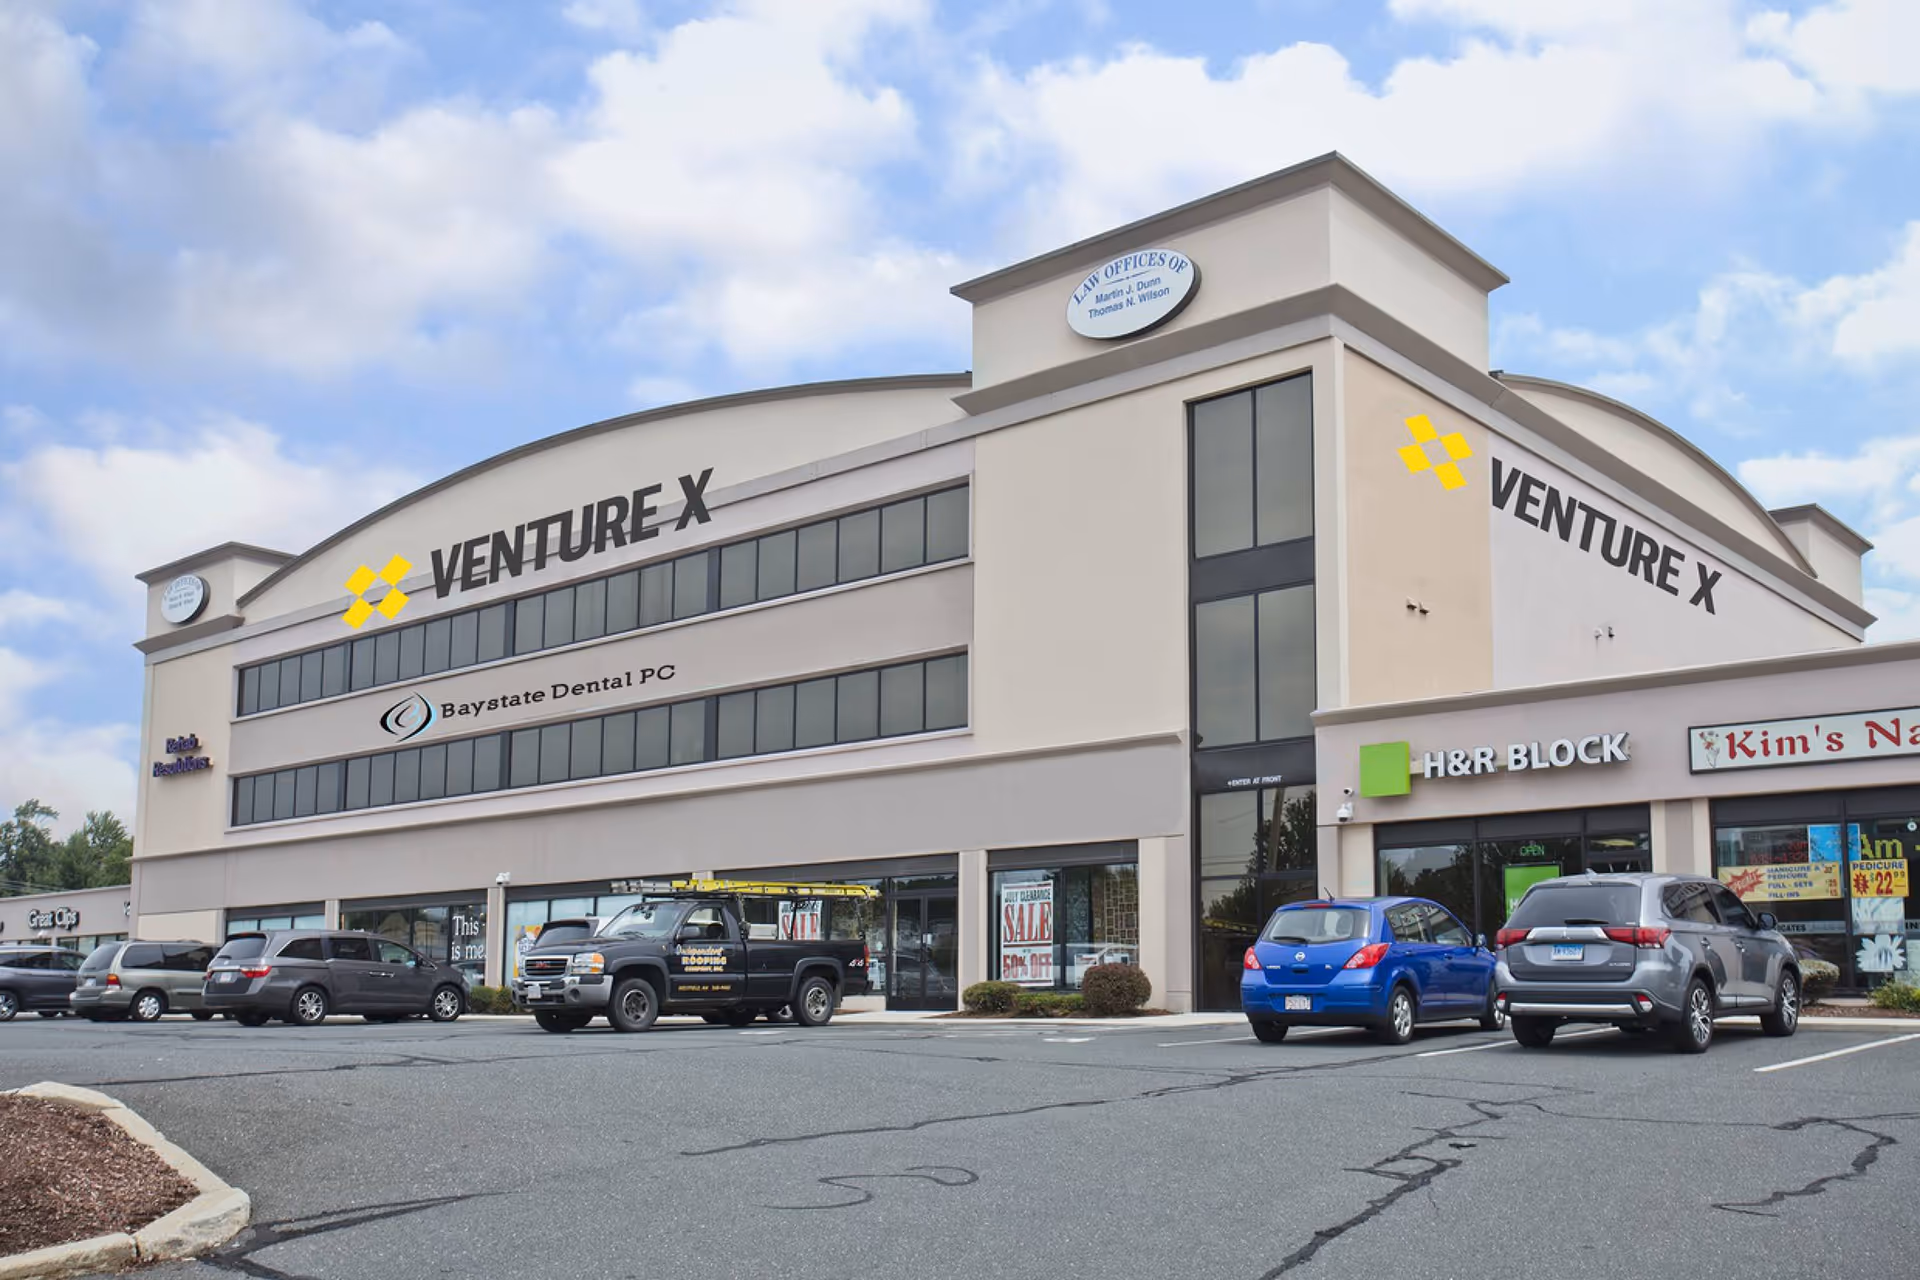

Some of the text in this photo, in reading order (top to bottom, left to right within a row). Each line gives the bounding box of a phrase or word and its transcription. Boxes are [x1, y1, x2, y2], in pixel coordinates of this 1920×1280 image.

[1073, 252, 1189, 305] LAW OFFICES OF
[1095, 277, 1161, 304] Martin J. Dunn
[1089, 287, 1170, 319] Thomas N. Wilson
[431, 467, 714, 599] VENTURE X
[1492, 457, 1723, 615] VENTURE X
[441, 665, 676, 718] Baystate Dental PC
[1424, 732, 1631, 779] H&R BLOCK
[1725, 724, 1845, 761] Kim's
[1232, 778, 1251, 787] ENTER
[1262, 775, 1282, 784] FRONT
[1852, 861, 1905, 871] PEDICURE
[1020, 888, 1051, 902] CLEARANCE
[452, 915, 479, 936] This
[1003, 902, 1052, 943] SALE
[451, 941, 460, 960] is
[682, 956, 727, 965] ROOFING
[1003, 952, 1052, 979] 50% OFF
